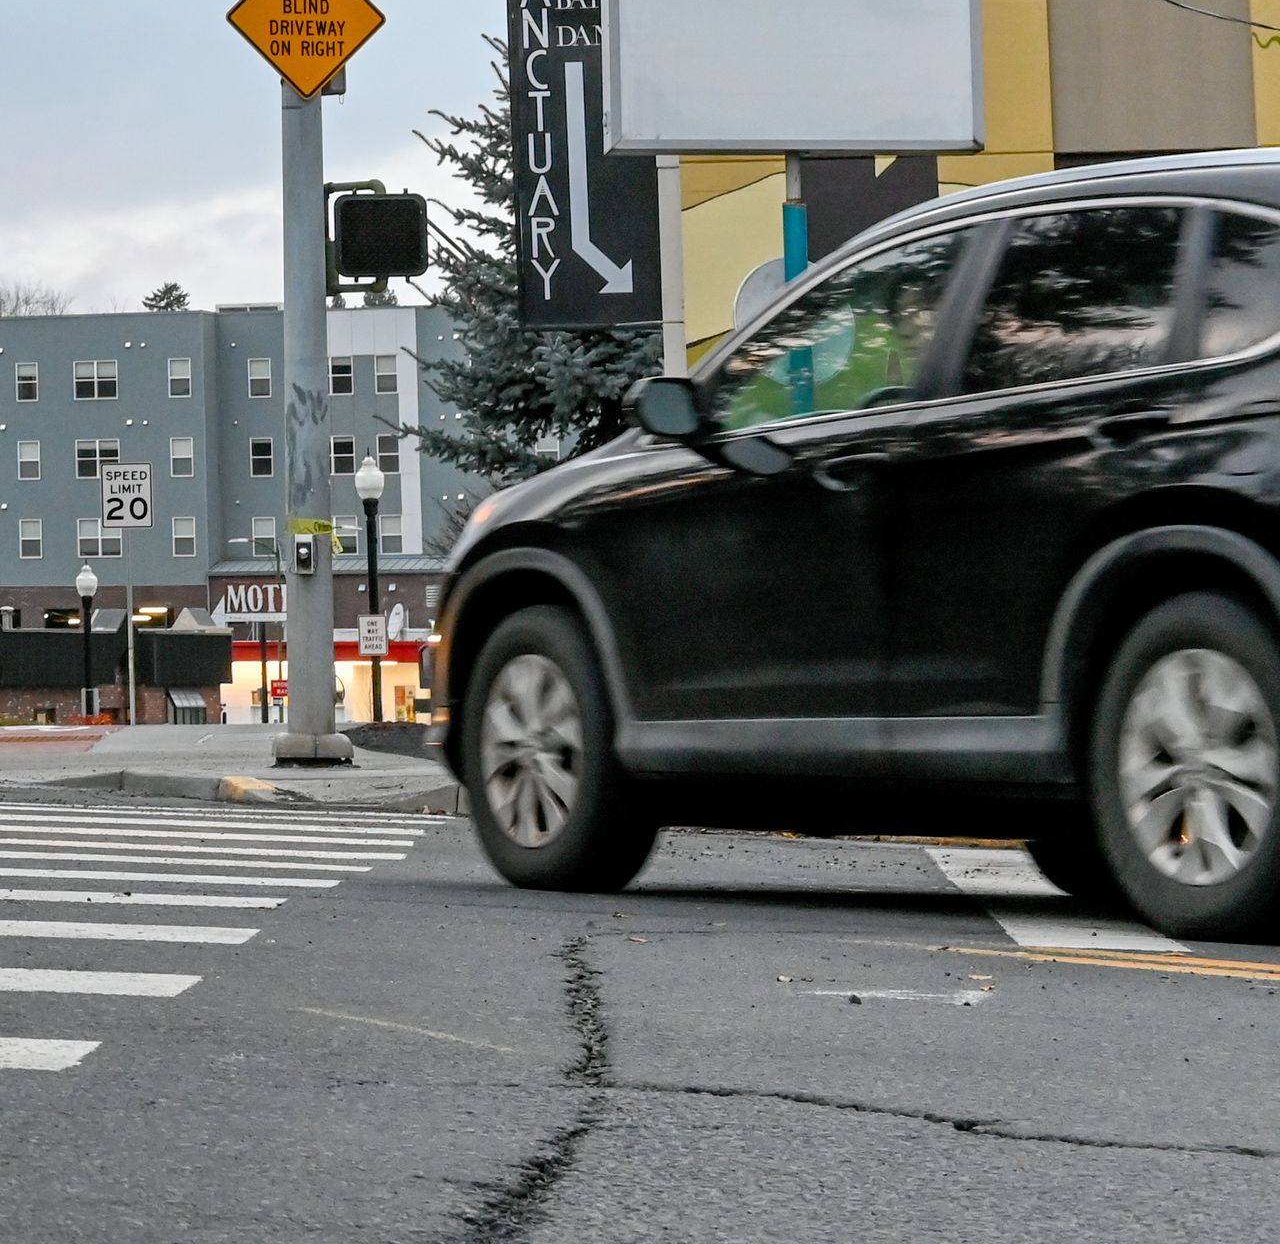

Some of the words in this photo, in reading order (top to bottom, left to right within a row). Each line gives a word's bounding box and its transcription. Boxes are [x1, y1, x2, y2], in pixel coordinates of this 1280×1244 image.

[282, 0, 330, 15] BLIND
[269, 20, 346, 36] DRIVEWAY
[270, 40, 291, 57] ON
[301, 40, 345, 57] RIGHT
[105, 470, 148, 481] SPEED
[110, 483, 143, 494] LIMIT
[106, 497, 148, 520] 20
[366, 620, 378, 628] ONE
[361, 635, 385, 643] TRAFFIC
[364, 643, 383, 651] AHEAD
